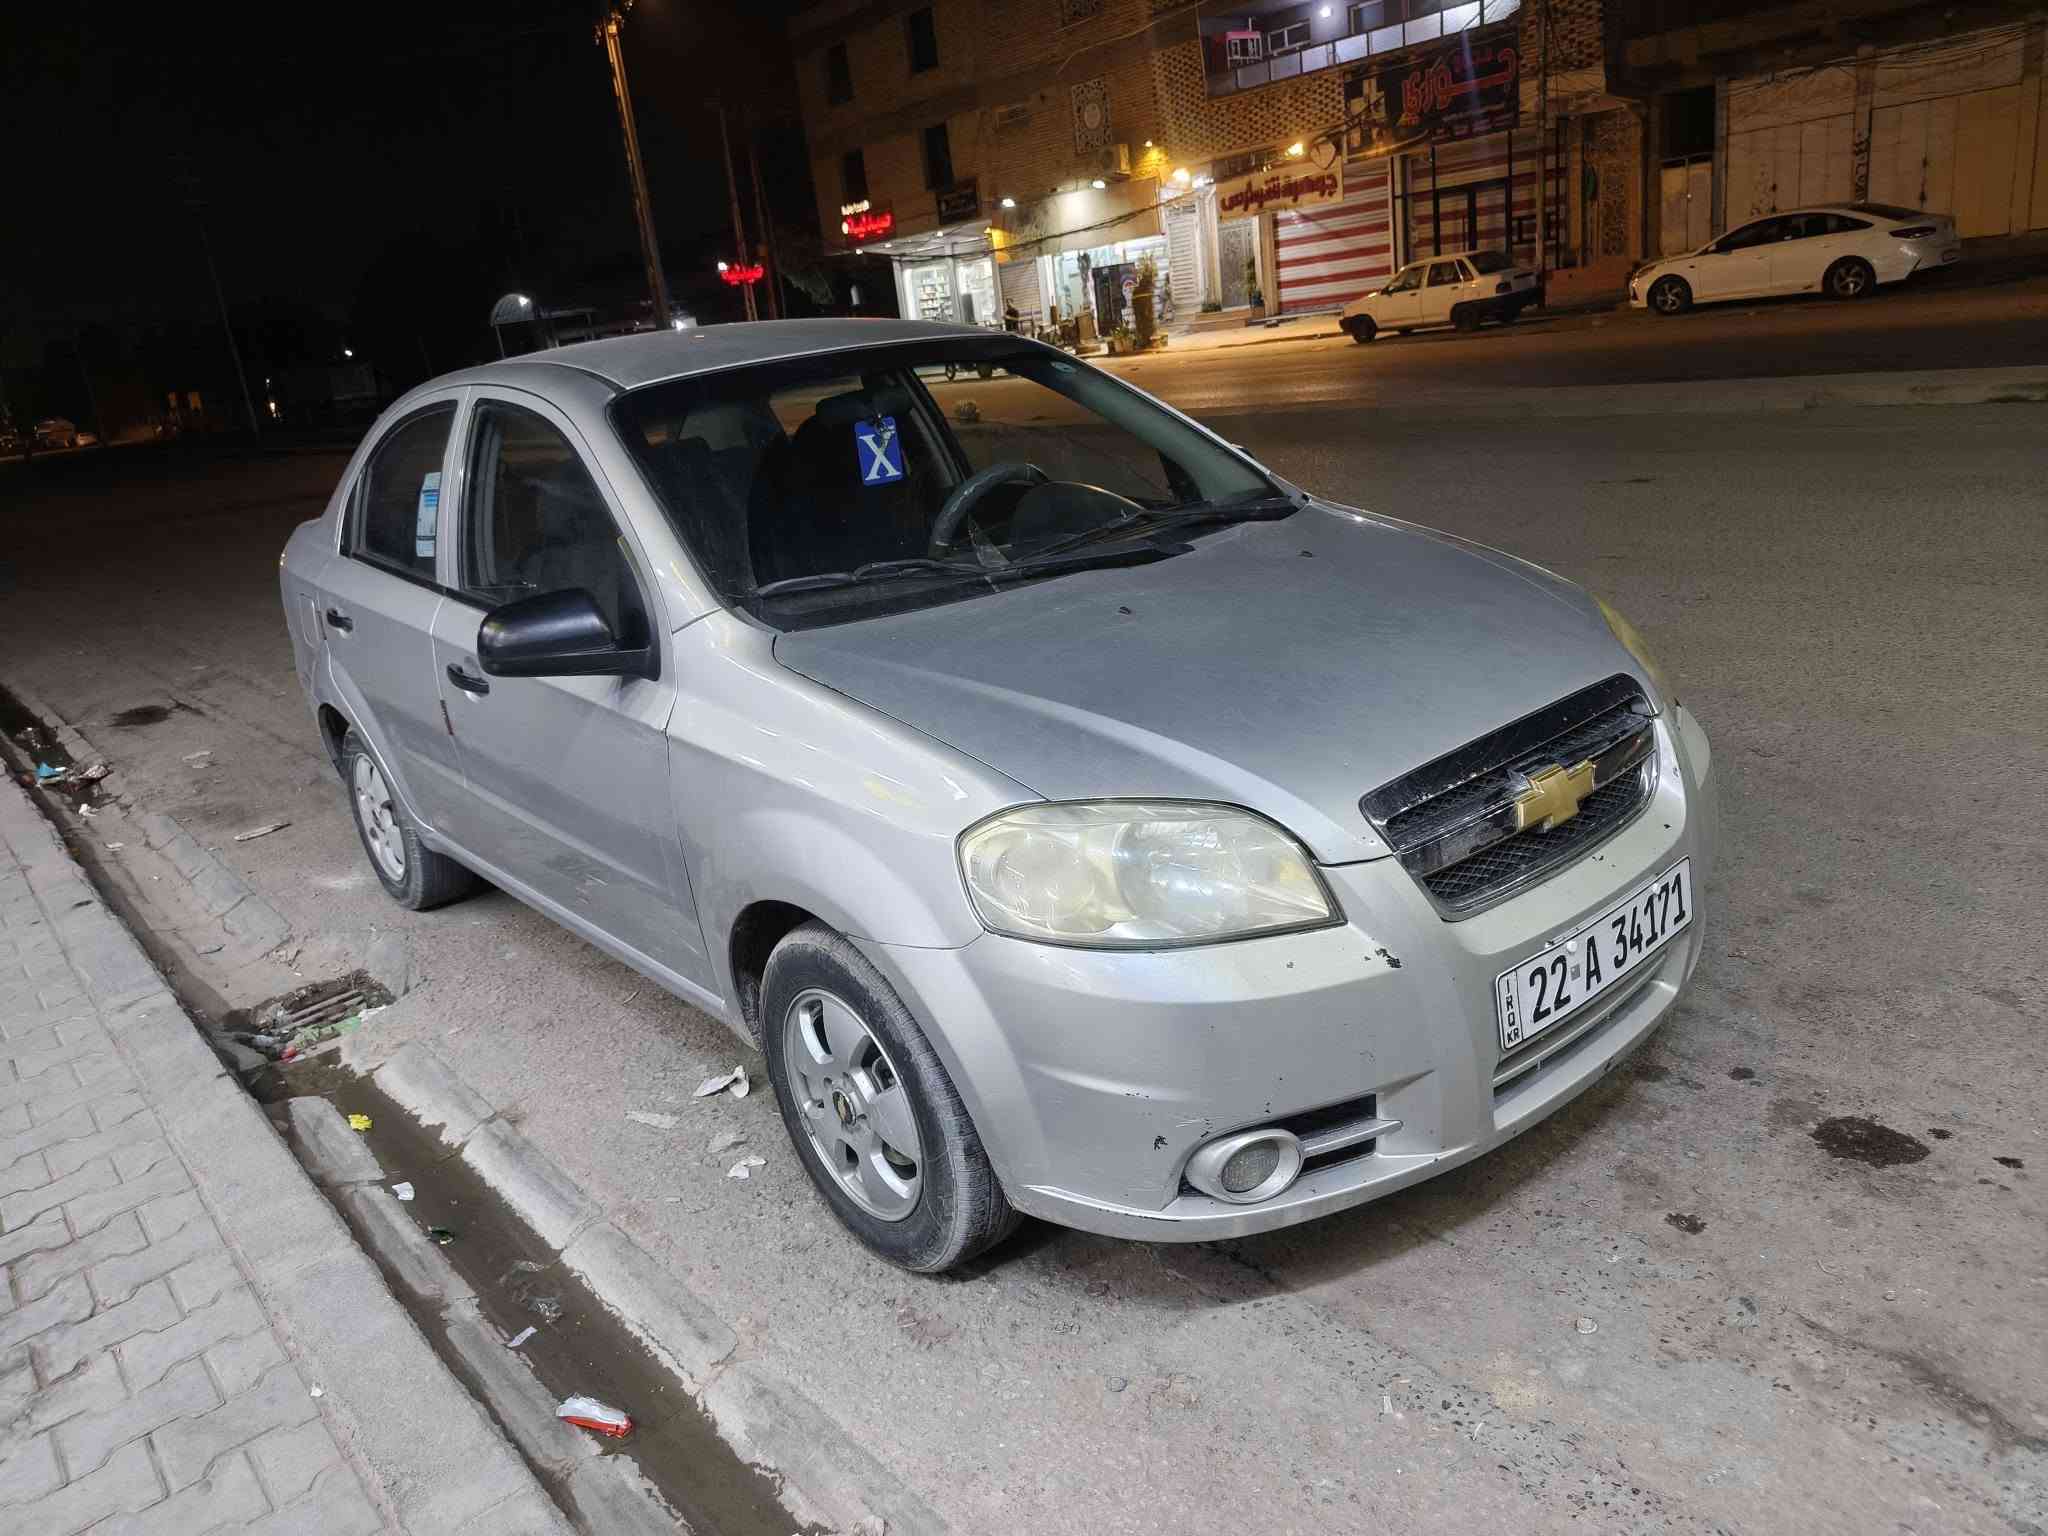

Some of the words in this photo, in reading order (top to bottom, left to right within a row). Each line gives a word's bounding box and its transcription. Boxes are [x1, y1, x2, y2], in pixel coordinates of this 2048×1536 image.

[859, 433, 901, 481] X
[1529, 955, 1571, 1024] 22
[1585, 936, 1602, 991] A
[1612, 873, 1686, 969] 34171
[1506, 1027, 1520, 1044] KR
